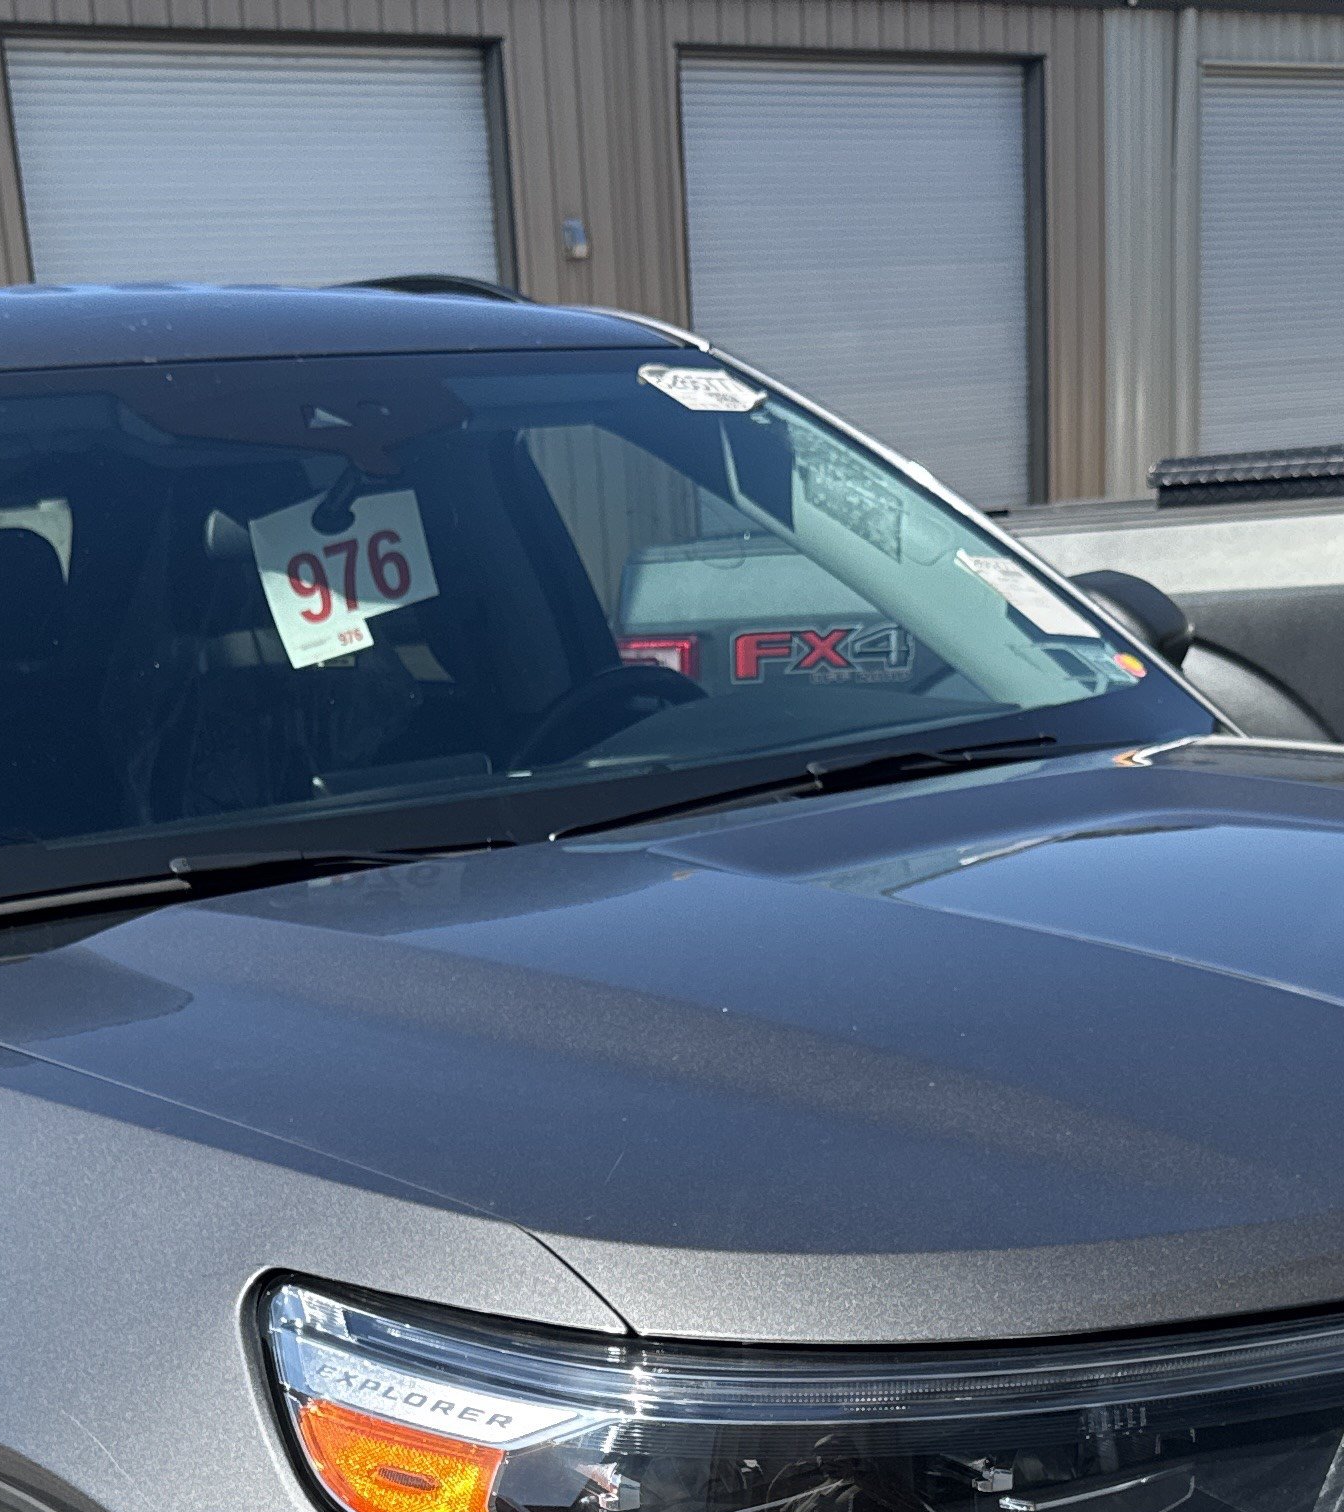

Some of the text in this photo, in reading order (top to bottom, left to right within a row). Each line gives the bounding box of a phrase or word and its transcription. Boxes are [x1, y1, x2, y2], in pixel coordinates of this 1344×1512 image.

[287, 529, 412, 625] 976
[338, 628, 364, 647] 976
[731, 623, 914, 684] FX4
[315, 1362, 514, 1430] EXPLORER
